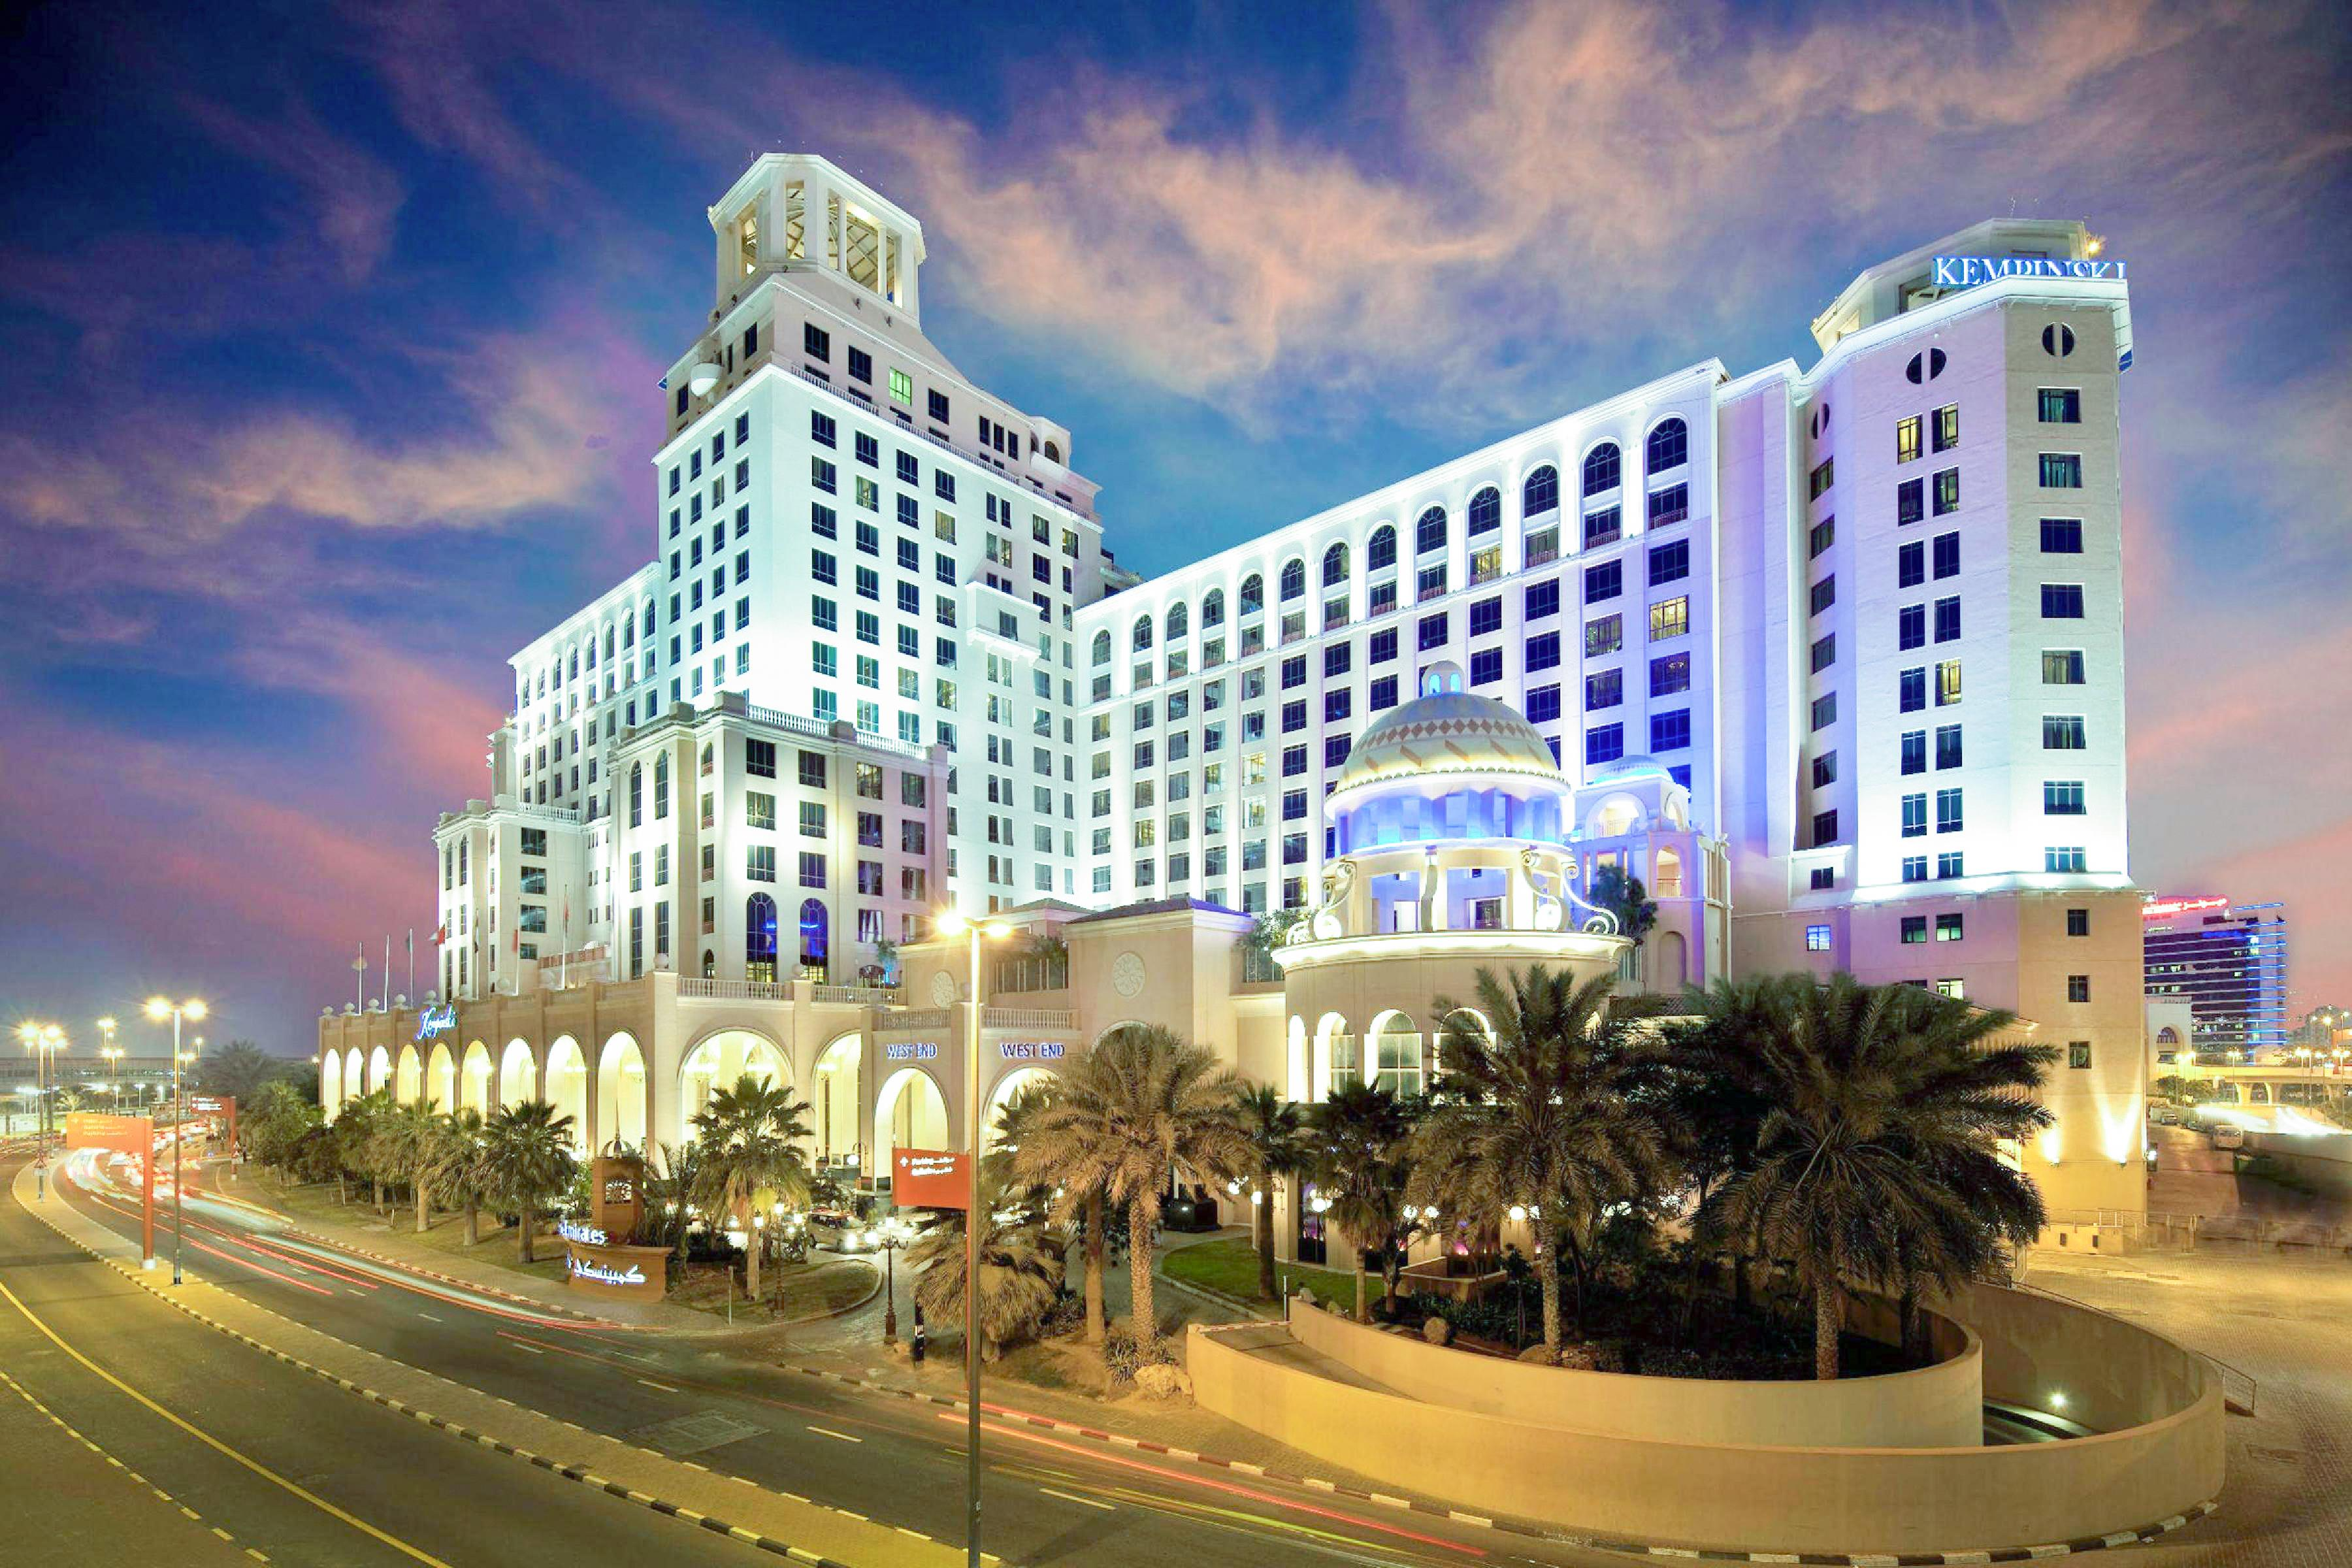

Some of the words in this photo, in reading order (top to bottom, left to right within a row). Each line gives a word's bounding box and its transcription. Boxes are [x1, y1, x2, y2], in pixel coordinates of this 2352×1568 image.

[1933, 257, 2125, 285] KEMPINSKI
[887, 1044, 913, 1058] WEST
[916, 1043, 938, 1058] END
[1000, 1043, 1038, 1058] WEST
[1041, 1043, 1065, 1058] END
